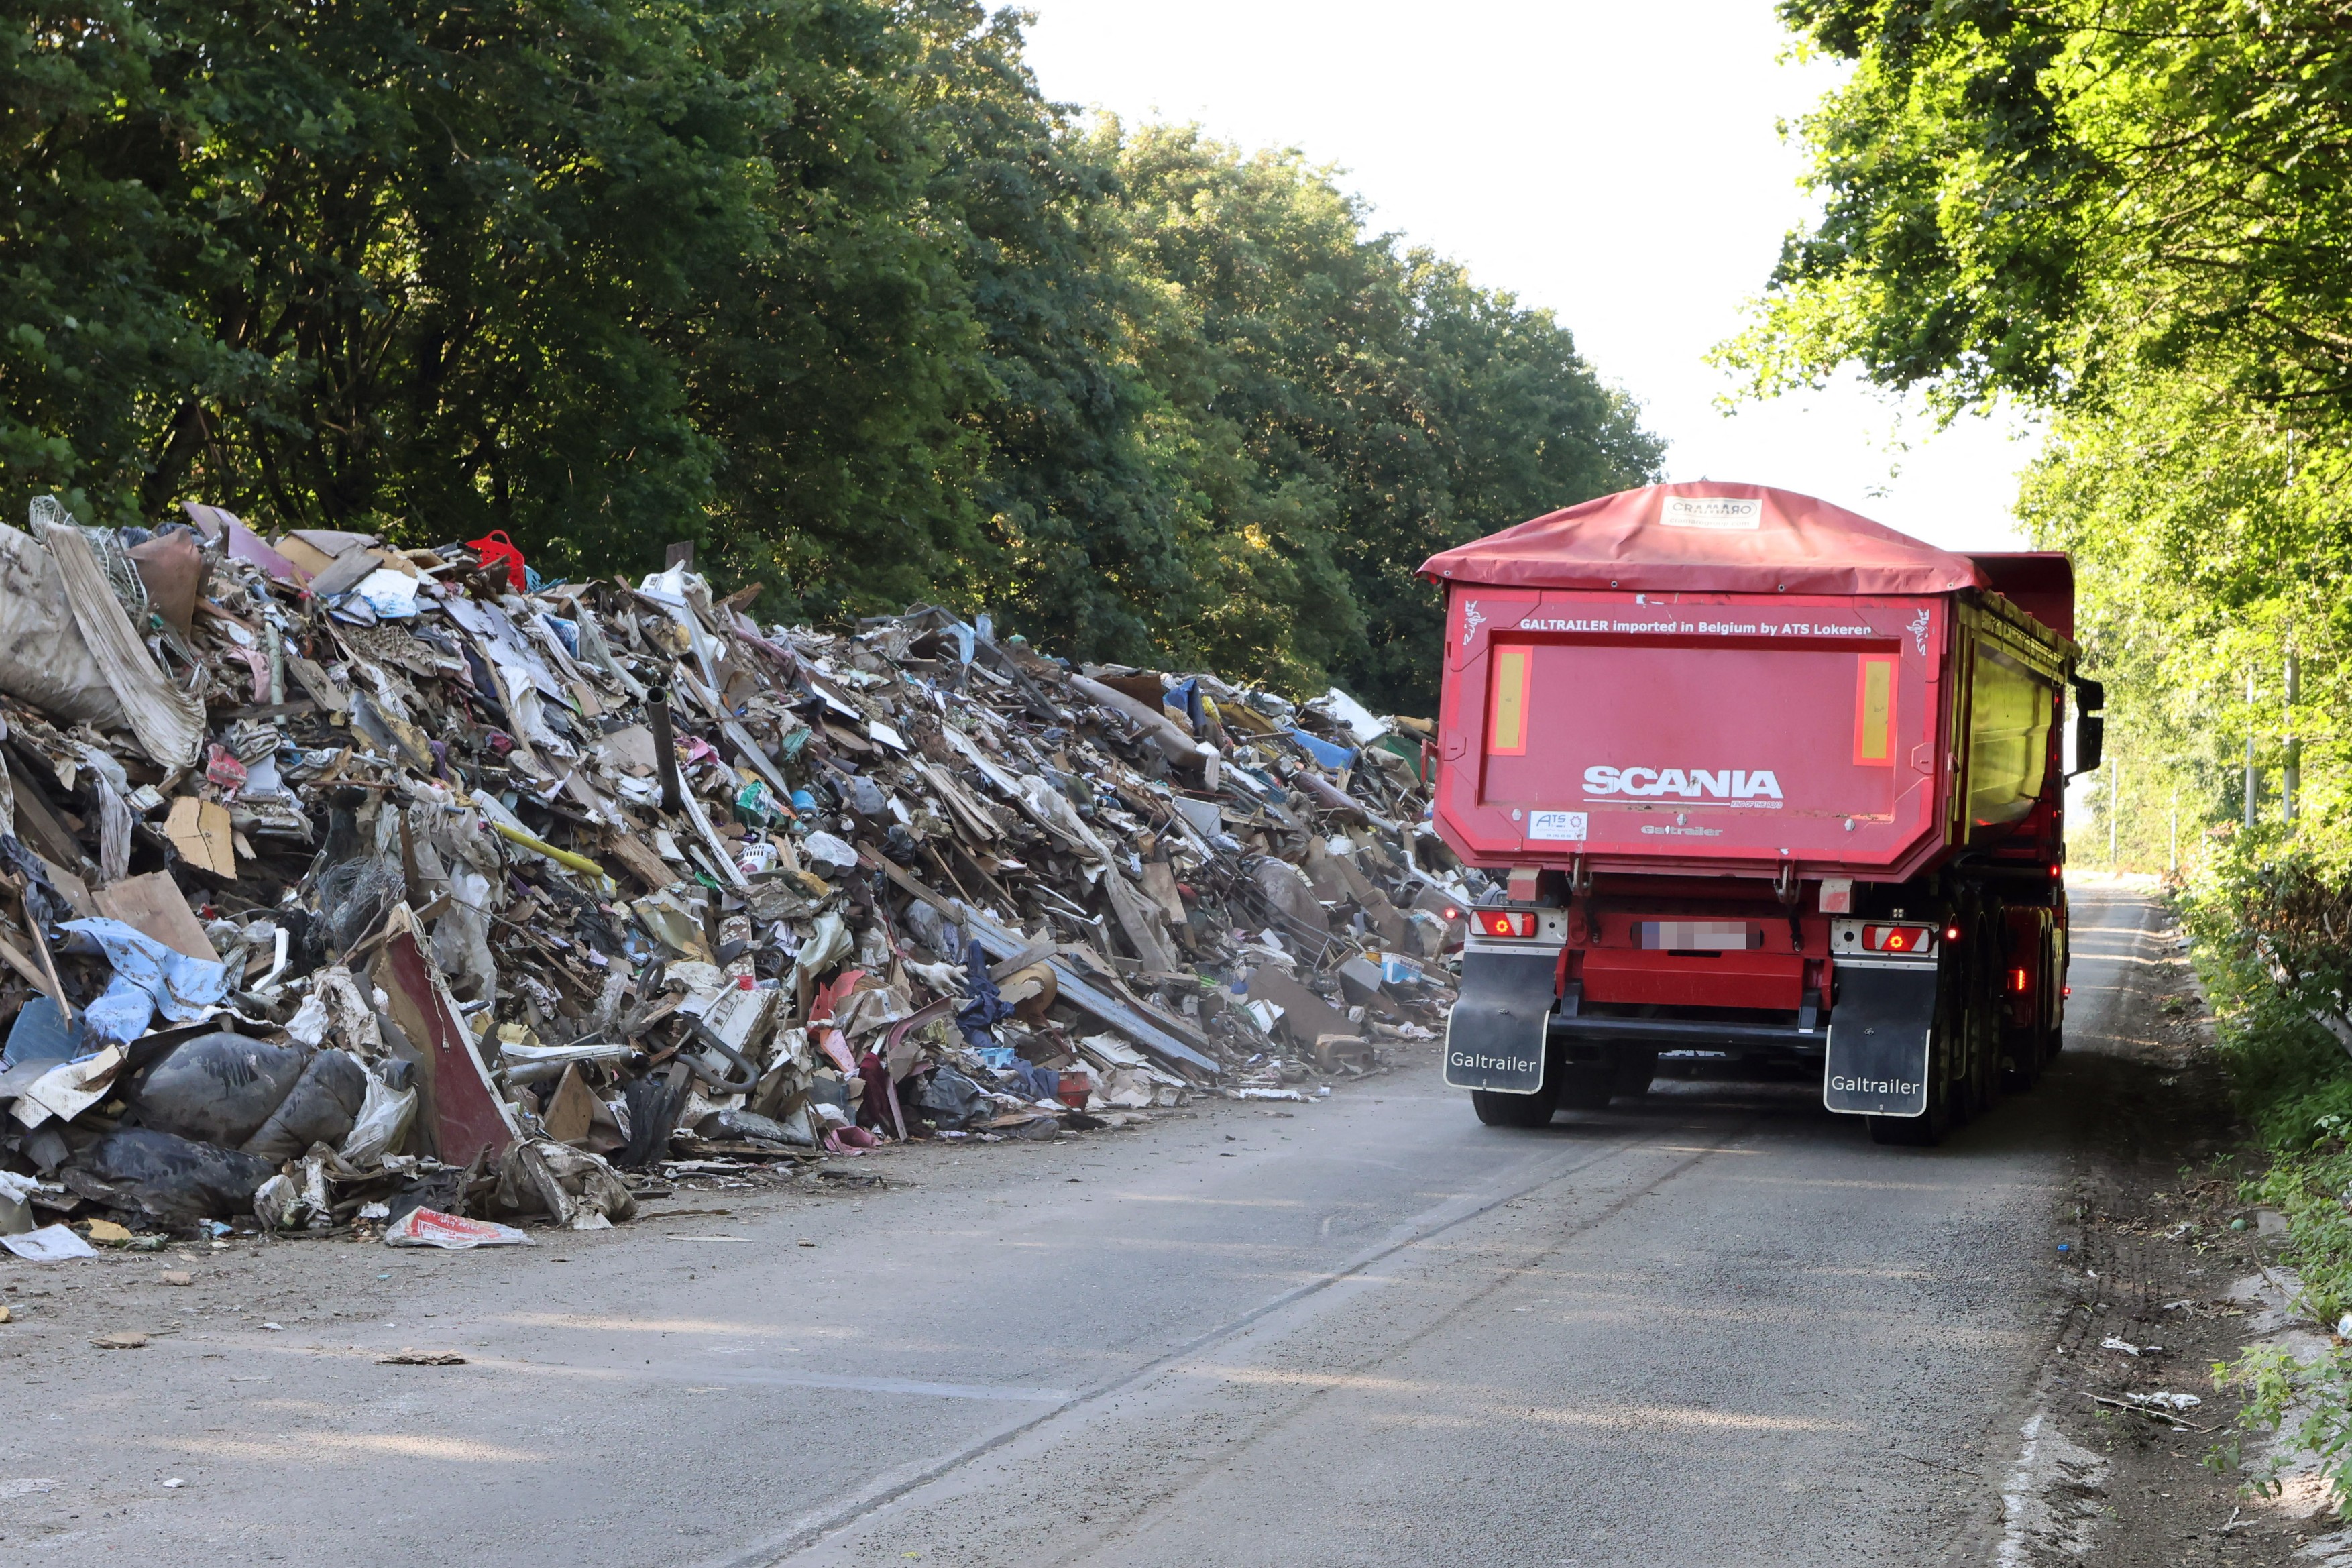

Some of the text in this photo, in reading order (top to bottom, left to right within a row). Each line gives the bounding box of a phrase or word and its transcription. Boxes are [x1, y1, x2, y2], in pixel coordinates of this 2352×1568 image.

[1672, 502, 1752, 514] CRAMARO
[1520, 618, 1872, 636] GALTRAILER imported in Belgium by ATS Lokeren
[1581, 765, 1784, 799] SCANIA
[1536, 814, 1566, 827] ATS
[1640, 825, 1724, 836] Galtrailer
[1451, 1052, 1537, 1072] Galtrailer
[1832, 1076, 1921, 1095] Galtrailer
